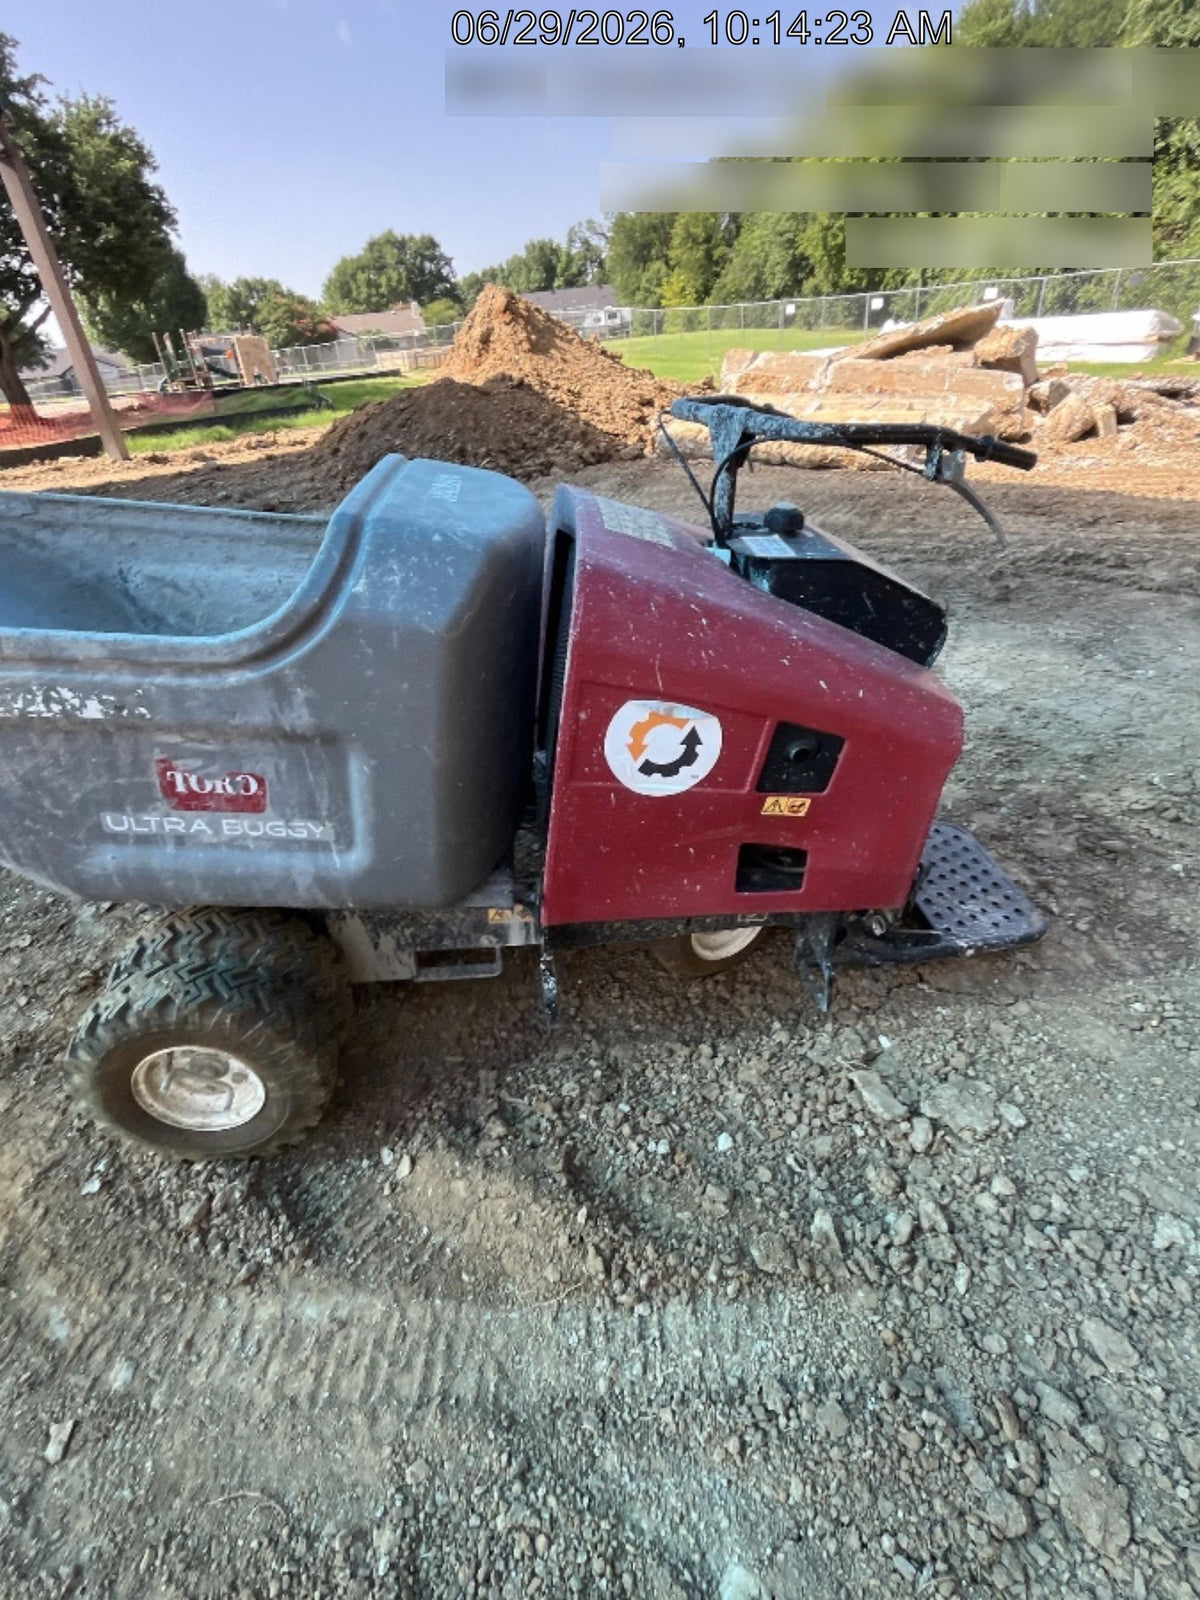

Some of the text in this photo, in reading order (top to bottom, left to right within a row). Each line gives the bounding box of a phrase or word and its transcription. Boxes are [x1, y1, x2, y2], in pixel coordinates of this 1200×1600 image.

[166, 770, 259, 796] TORO
[105, 815, 326, 839] ULTRA BUGGY
